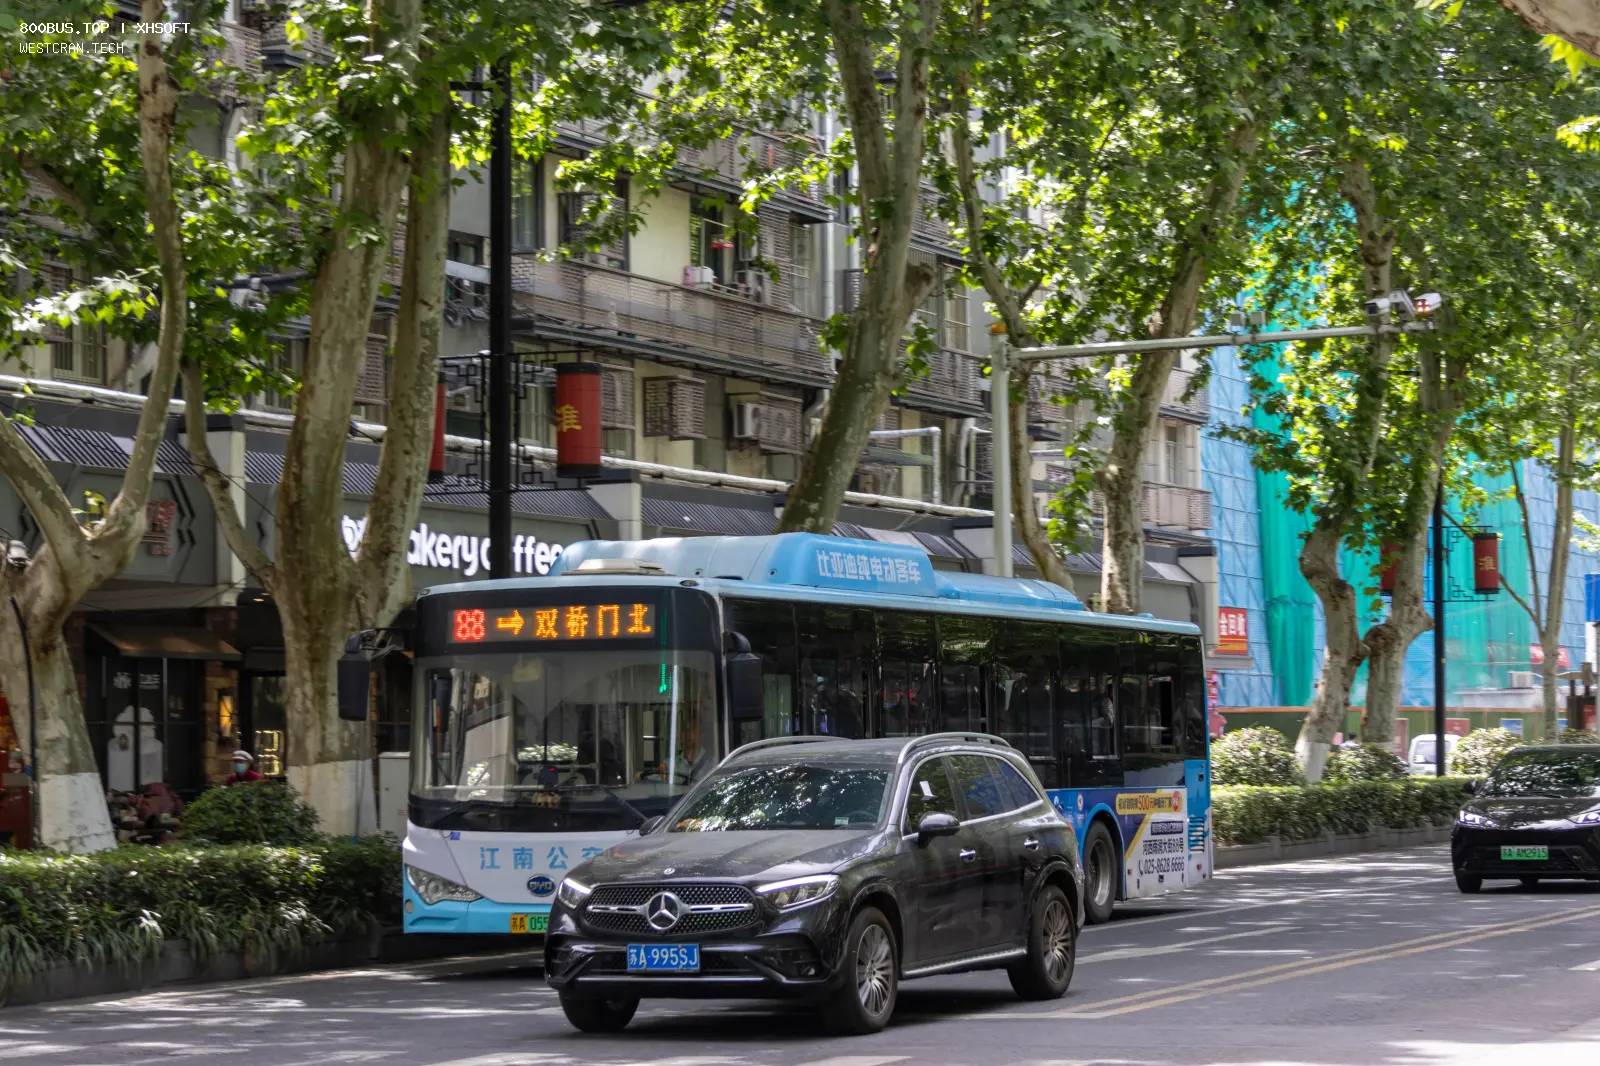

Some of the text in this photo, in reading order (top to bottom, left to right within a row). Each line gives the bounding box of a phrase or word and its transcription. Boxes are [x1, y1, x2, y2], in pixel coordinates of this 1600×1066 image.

[816, 549, 922, 585] 比亚迪纯电动客车
[456, 603, 652, 641] 88 双桥门北
[529, 881, 553, 891] BYD
